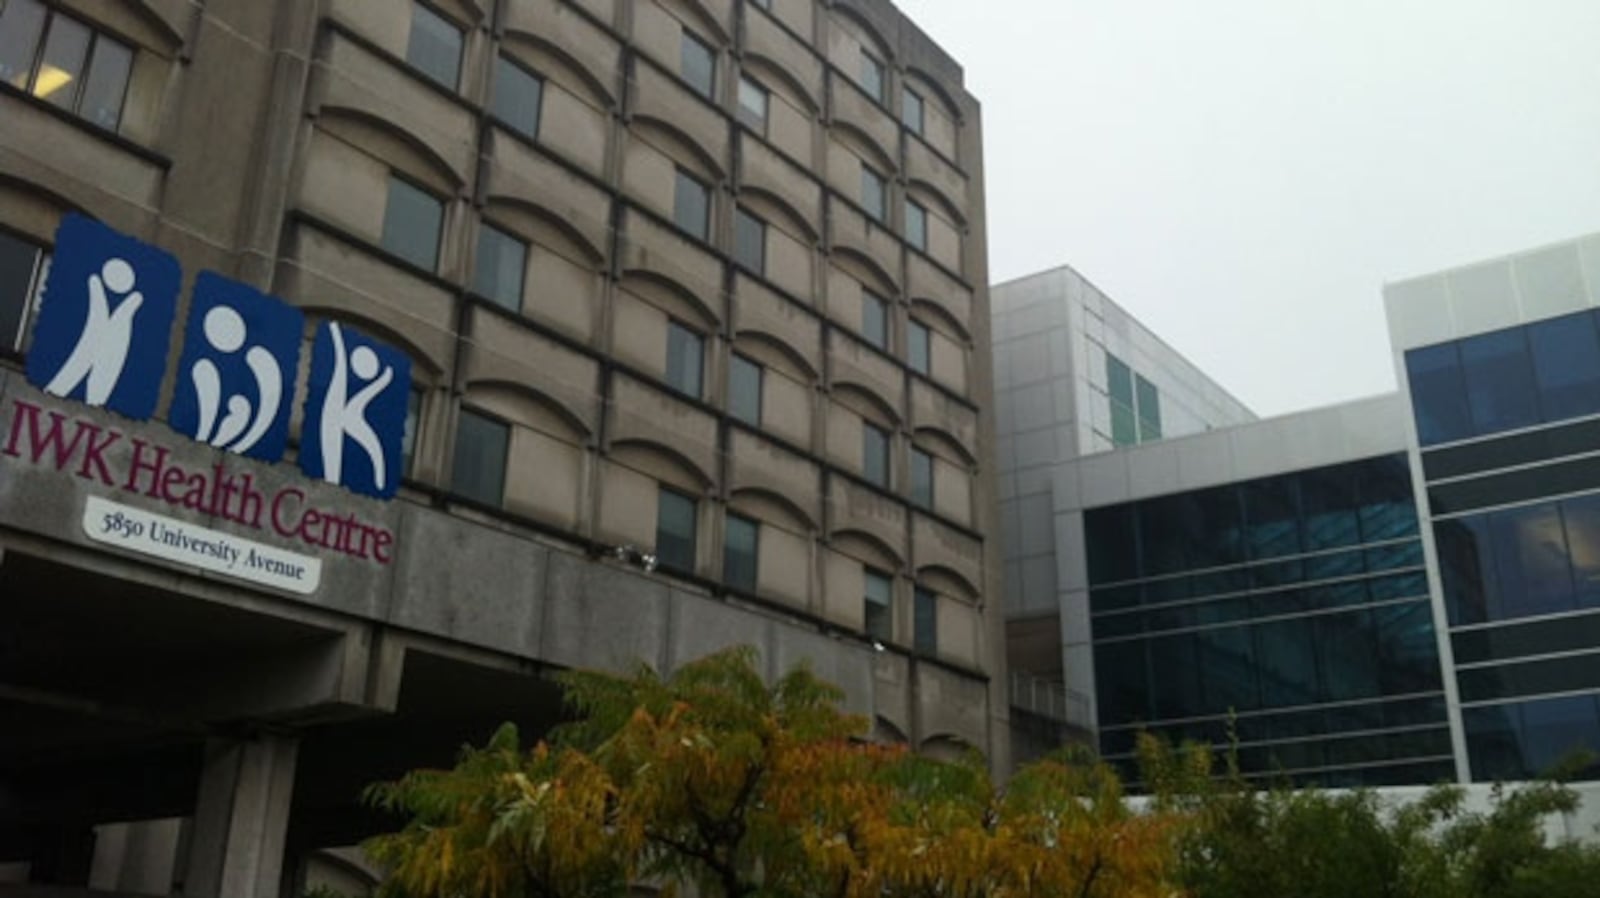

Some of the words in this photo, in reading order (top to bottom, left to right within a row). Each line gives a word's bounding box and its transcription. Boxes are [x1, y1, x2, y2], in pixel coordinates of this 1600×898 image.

[2, 401, 122, 487] IWK
[123, 438, 263, 529] Health
[271, 488, 393, 564] Centre
[101, 511, 144, 538] 5850
[148, 521, 241, 568] University
[243, 548, 305, 580] Avenue
